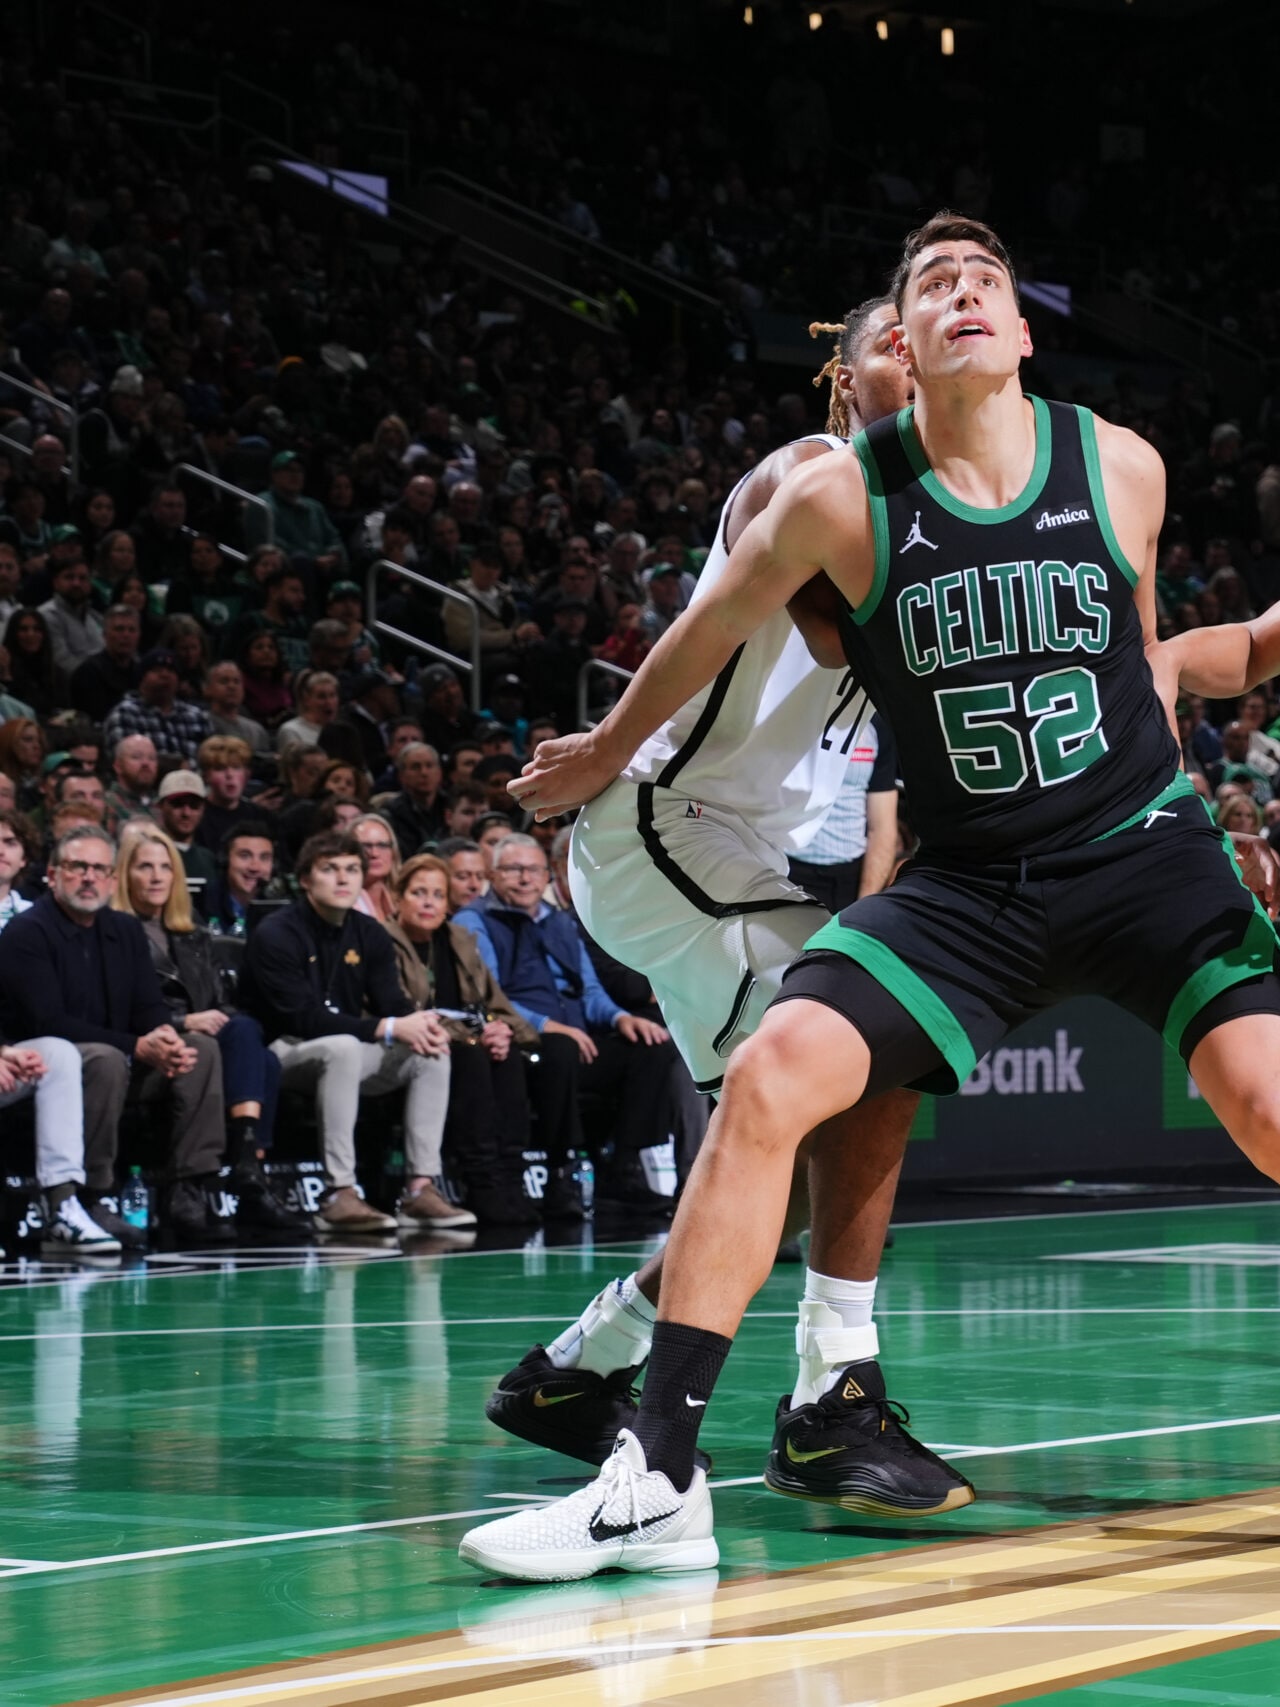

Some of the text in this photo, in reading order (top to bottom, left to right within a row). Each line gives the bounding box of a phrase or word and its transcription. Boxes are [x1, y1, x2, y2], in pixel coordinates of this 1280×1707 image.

[1035, 506, 1090, 531] Amica
[896, 560, 1111, 677] CELTICS
[933, 666, 1110, 795] 52
